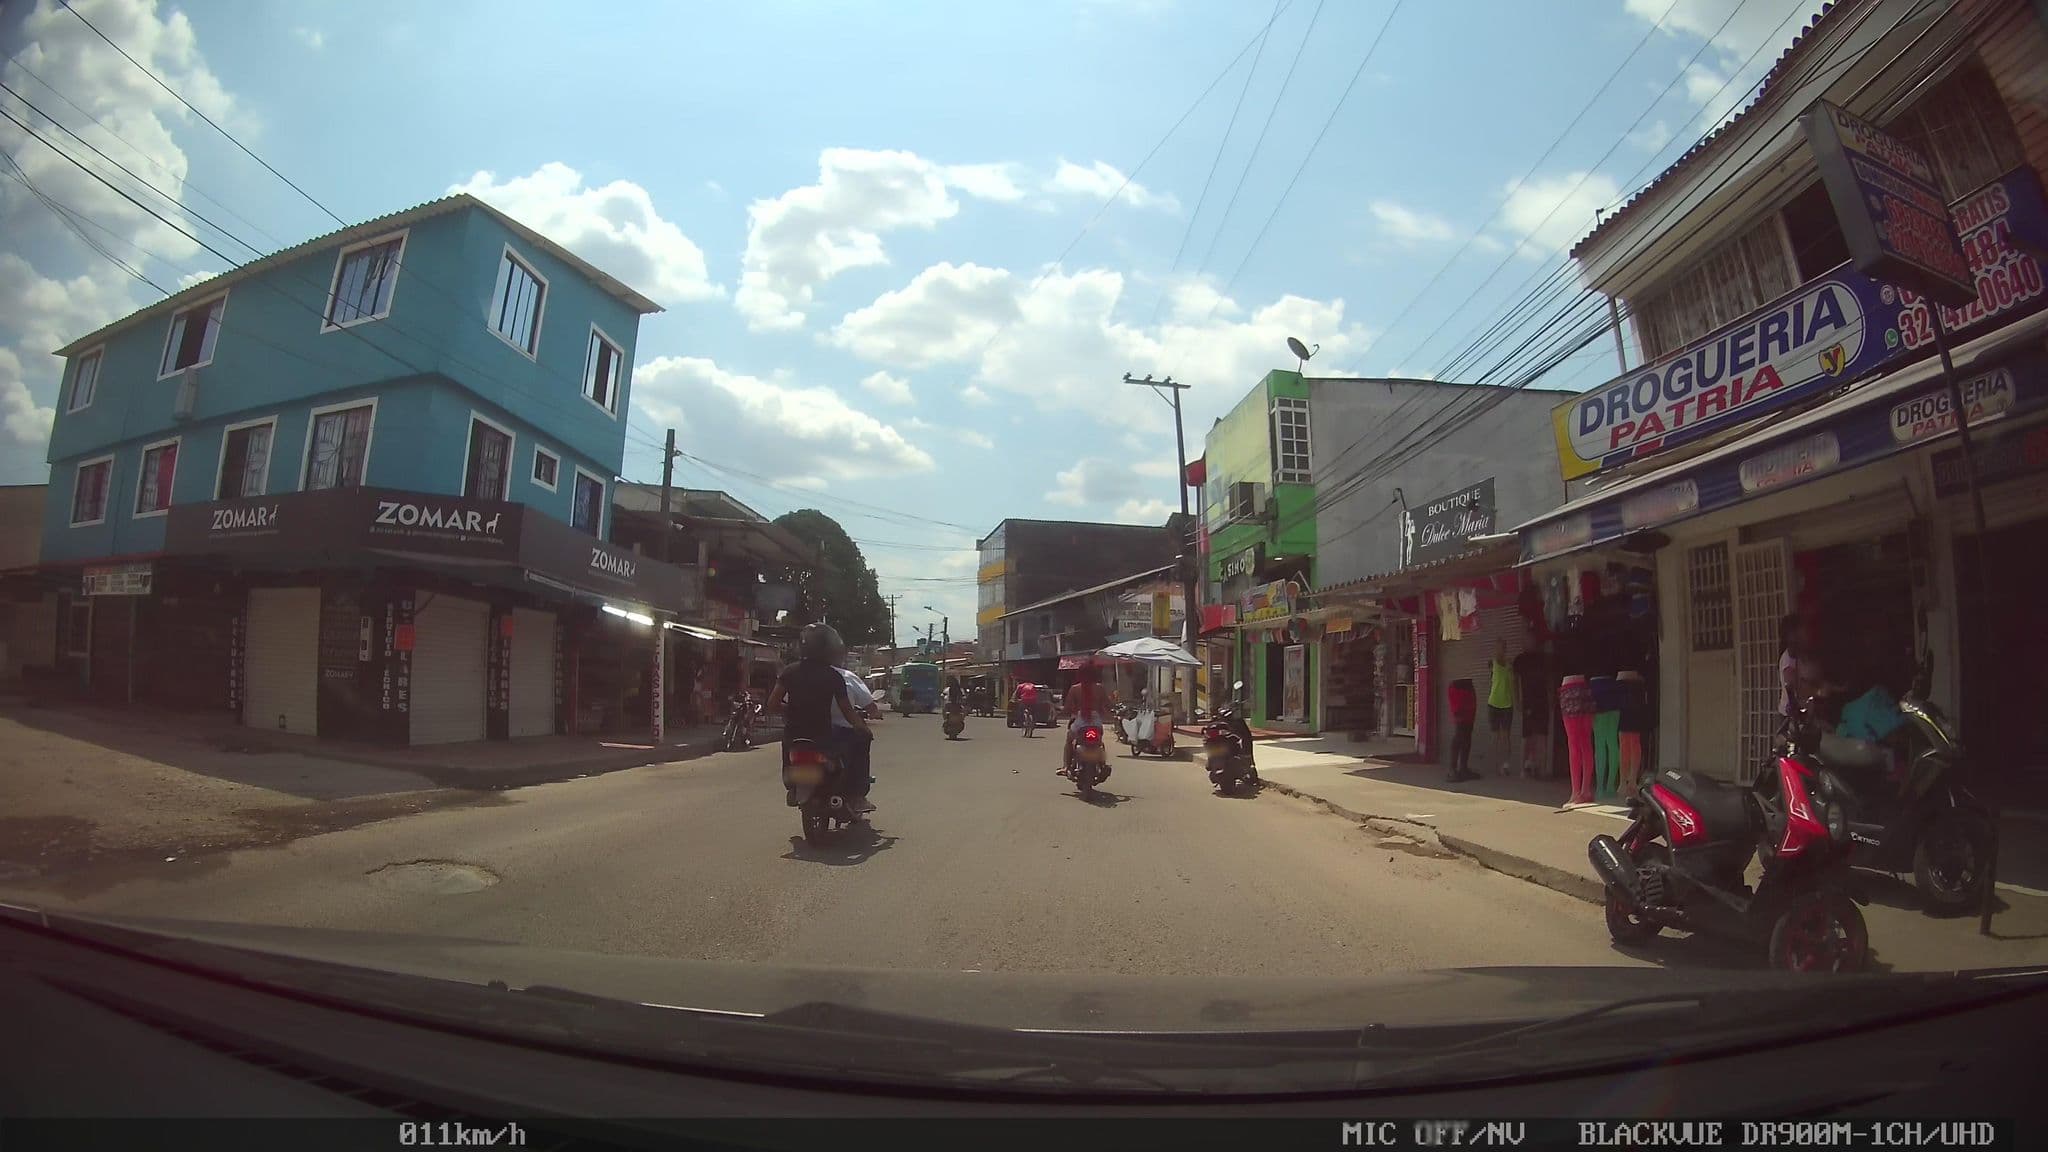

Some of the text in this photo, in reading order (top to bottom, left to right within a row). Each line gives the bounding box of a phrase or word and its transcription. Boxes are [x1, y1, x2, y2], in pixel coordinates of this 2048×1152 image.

[1953, 186, 2007, 232] RATIS
[1579, 287, 1847, 436] DROGUERIA
[1609, 364, 1784, 450] PATRIA
[1897, 371, 2008, 427] DROGERIA
[211, 507, 267, 530] ZOMAR
[375, 501, 482, 532] ZOMAR
[591, 548, 630, 577] ZOMAR
